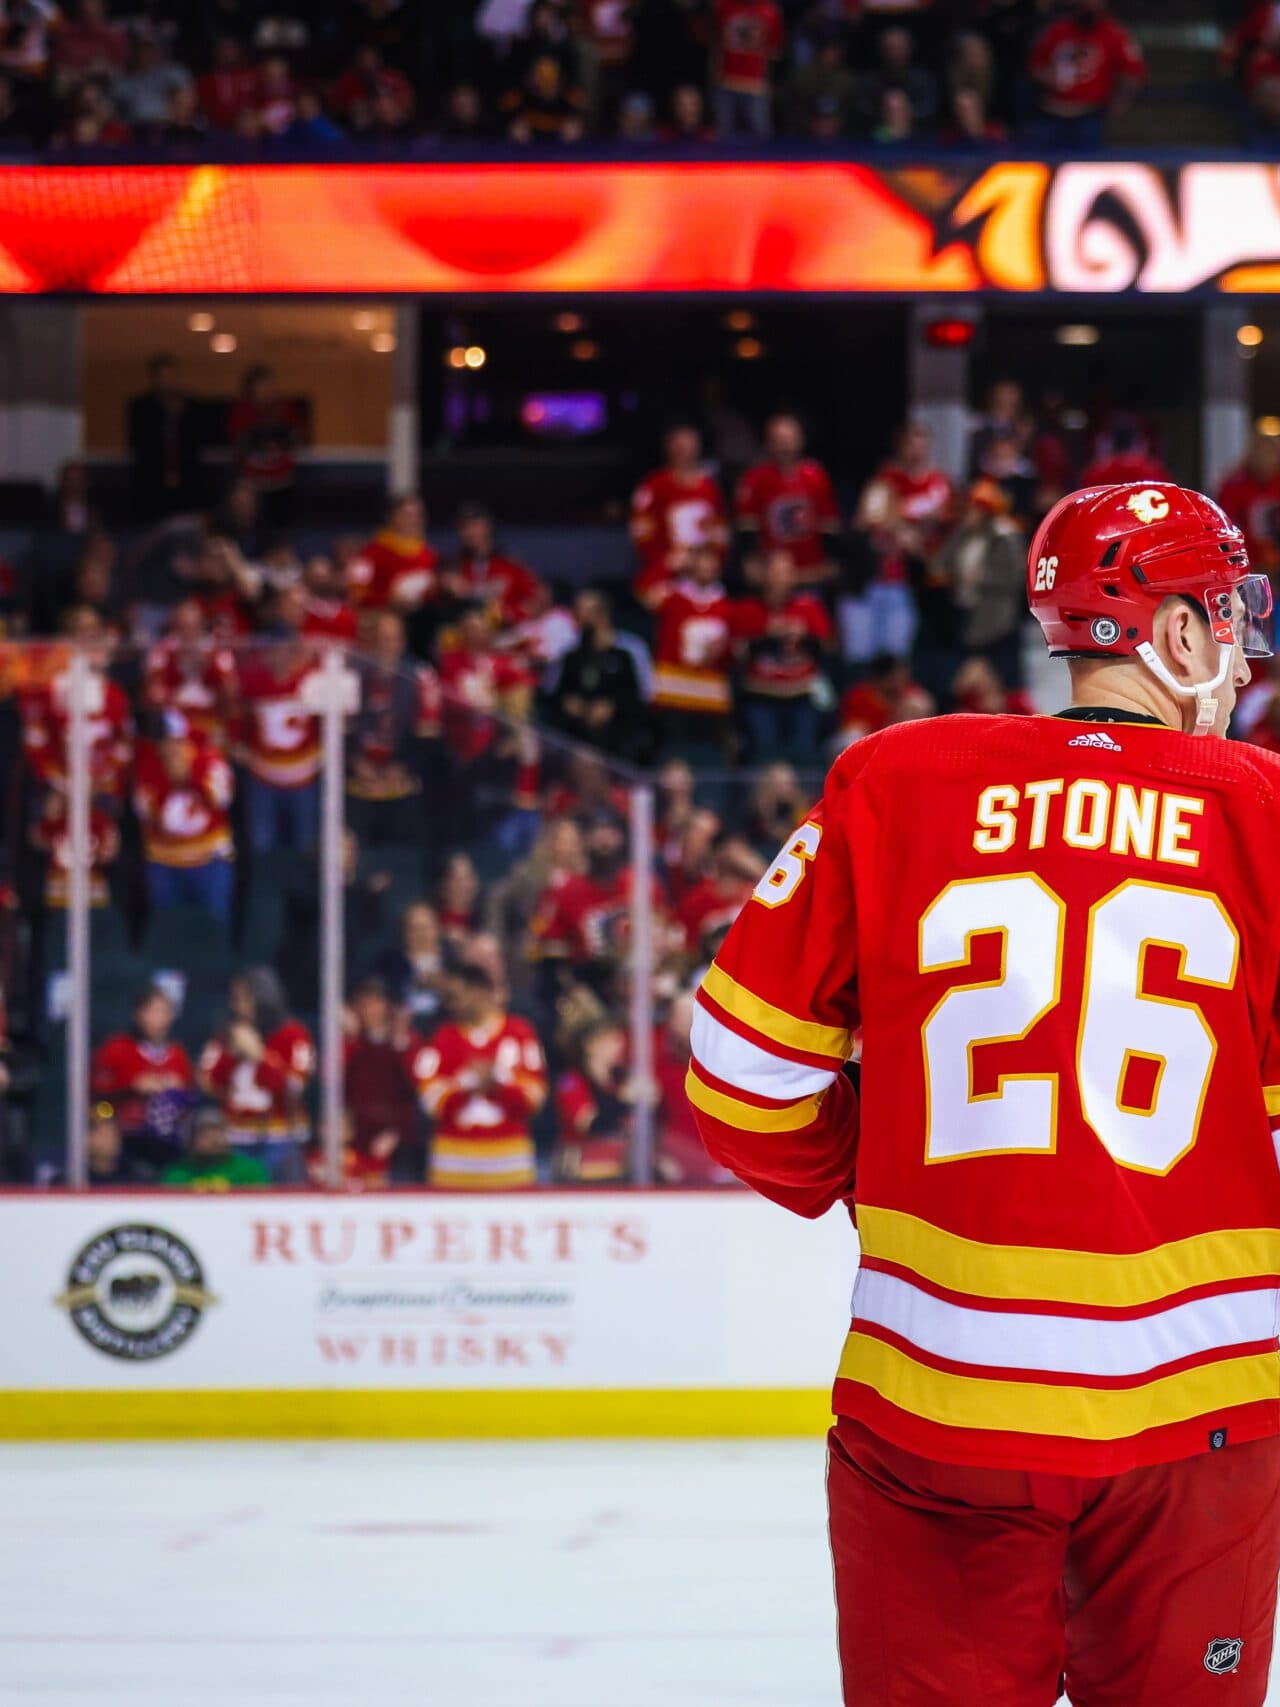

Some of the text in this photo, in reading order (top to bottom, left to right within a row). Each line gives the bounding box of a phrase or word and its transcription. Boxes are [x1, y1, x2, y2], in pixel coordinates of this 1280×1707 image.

[1034, 556, 1059, 592] 26
[1068, 736, 1122, 752] adidas
[973, 778, 1204, 867] STONE
[918, 871, 1240, 1176] 26
[250, 1217, 650, 1266] RUPERT'S
[316, 1334, 575, 1366] WHISKY
[1212, 1646, 1235, 1666] NHL
